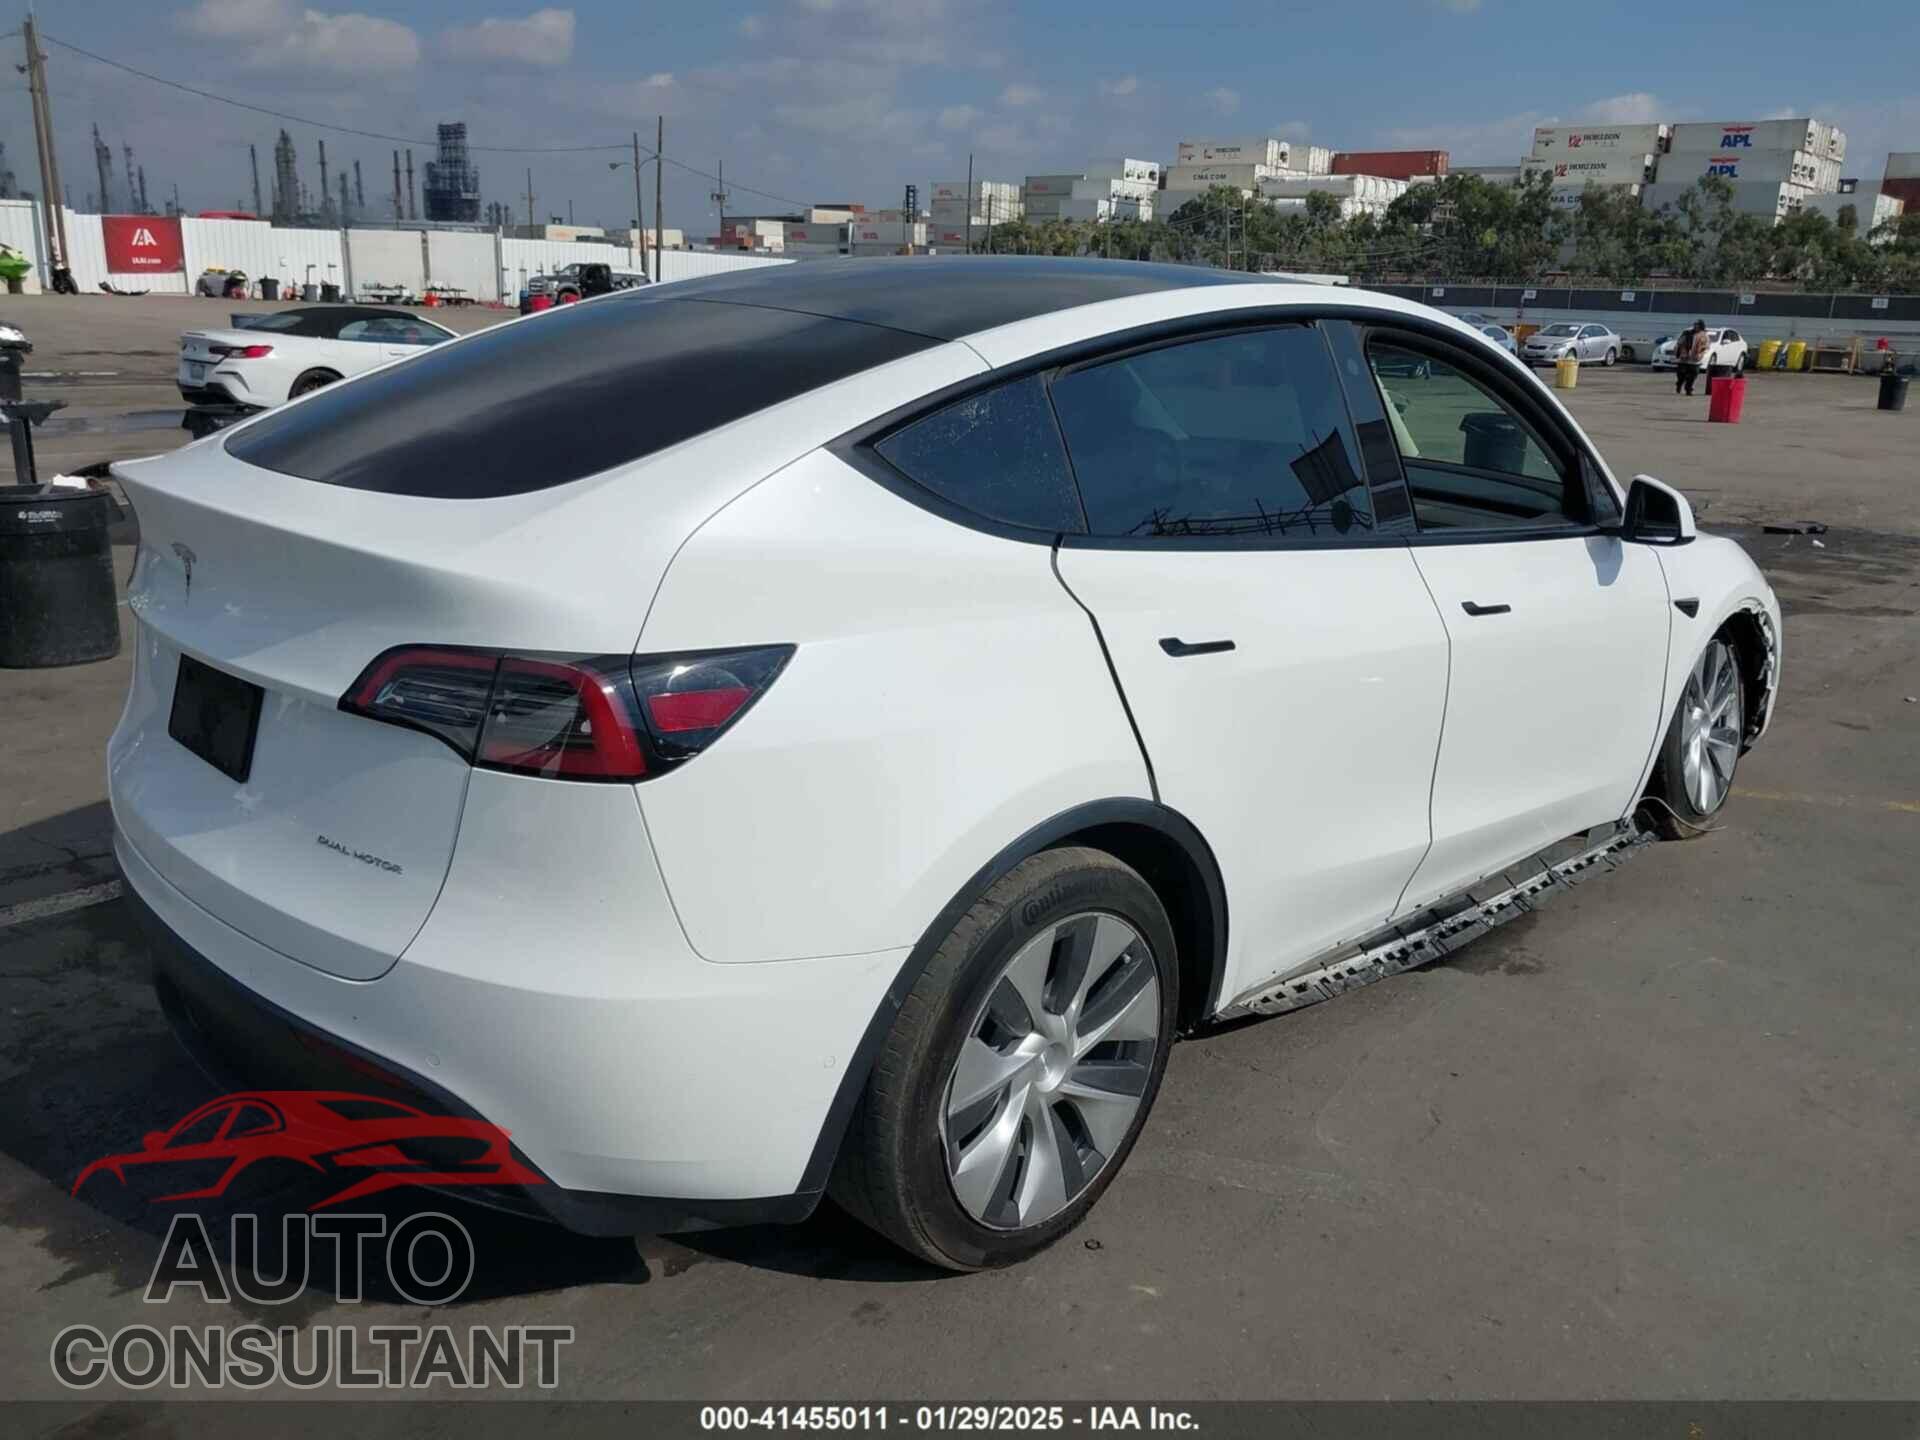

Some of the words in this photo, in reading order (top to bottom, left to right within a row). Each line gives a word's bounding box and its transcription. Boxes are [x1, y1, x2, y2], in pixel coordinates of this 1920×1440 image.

[1720, 134, 1752, 148] APL
[1704, 165, 1738, 178] APL
[317, 834, 351, 856] DUAL
[353, 850, 403, 876] MOTOR
